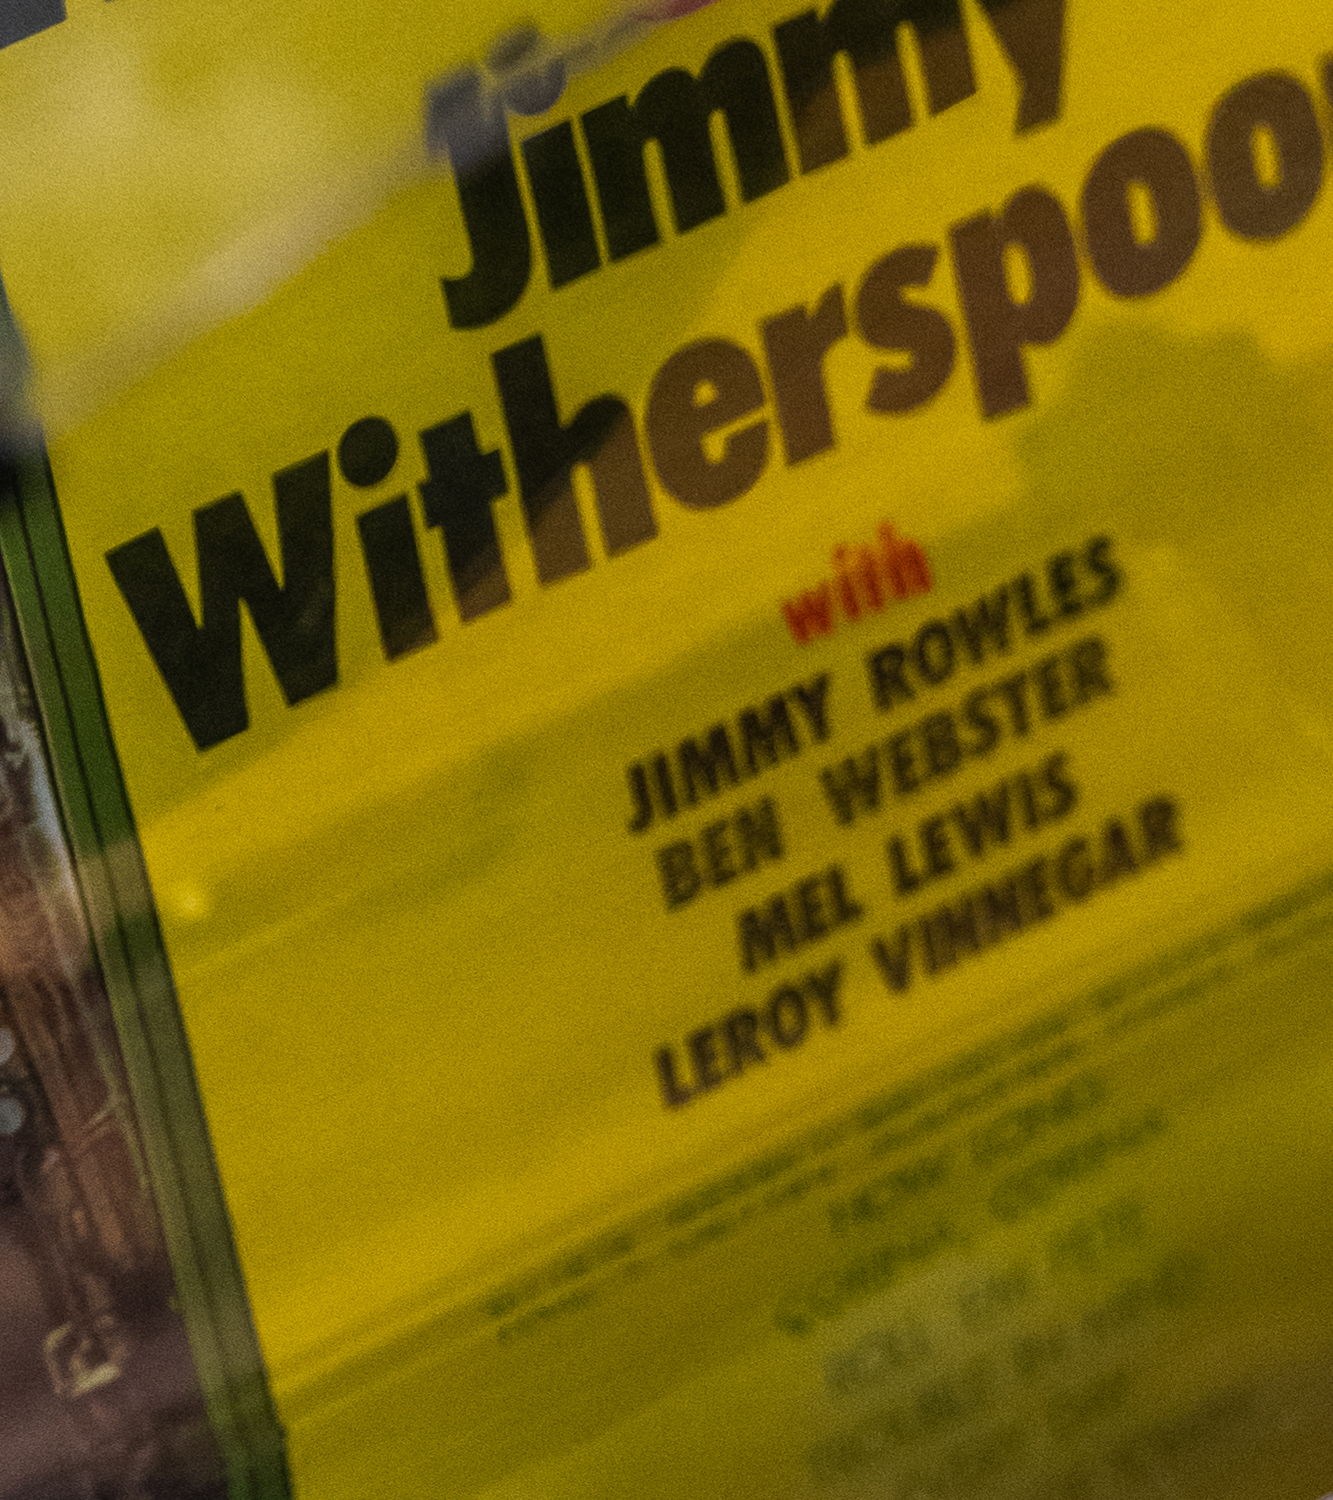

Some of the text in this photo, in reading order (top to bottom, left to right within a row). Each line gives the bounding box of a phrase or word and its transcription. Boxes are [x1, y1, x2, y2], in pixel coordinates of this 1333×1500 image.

[625, 534, 1125, 835] JIMMY ROWLES
[783, 522, 932, 645] with
[655, 636, 1118, 912] BEN WEBSTER
[736, 751, 1080, 975] MEL LEWIS
[654, 792, 1185, 1110] LEROY VINNEGAR
